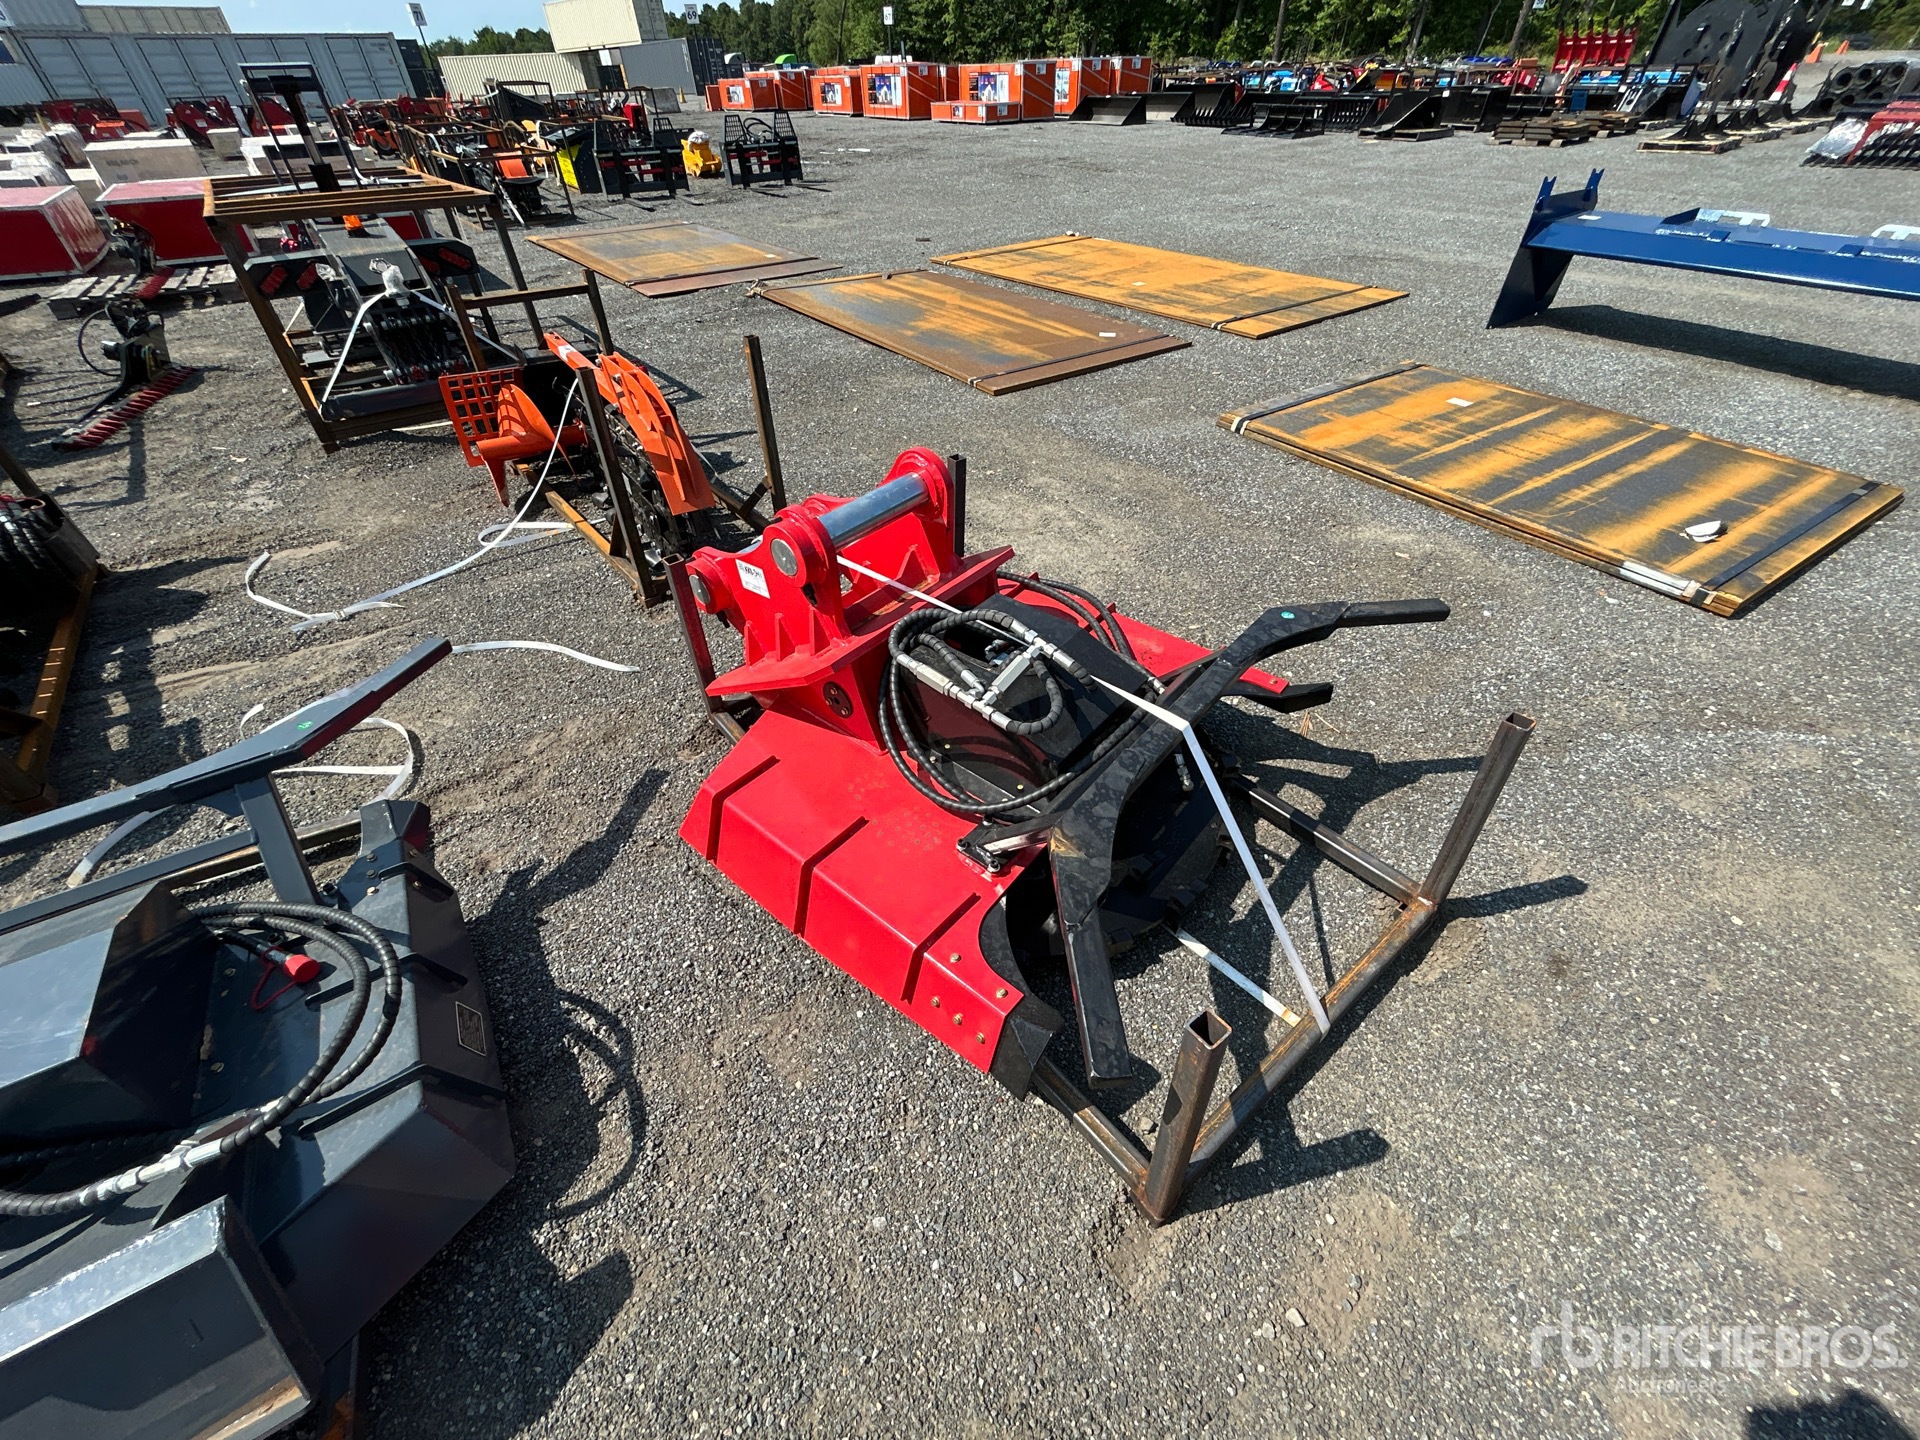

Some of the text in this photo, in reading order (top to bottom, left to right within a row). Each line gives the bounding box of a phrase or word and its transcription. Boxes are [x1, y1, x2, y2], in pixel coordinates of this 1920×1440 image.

[412, 11, 424, 21] 71
[687, 11, 697, 20] 69
[885, 13, 892, 21] 67
